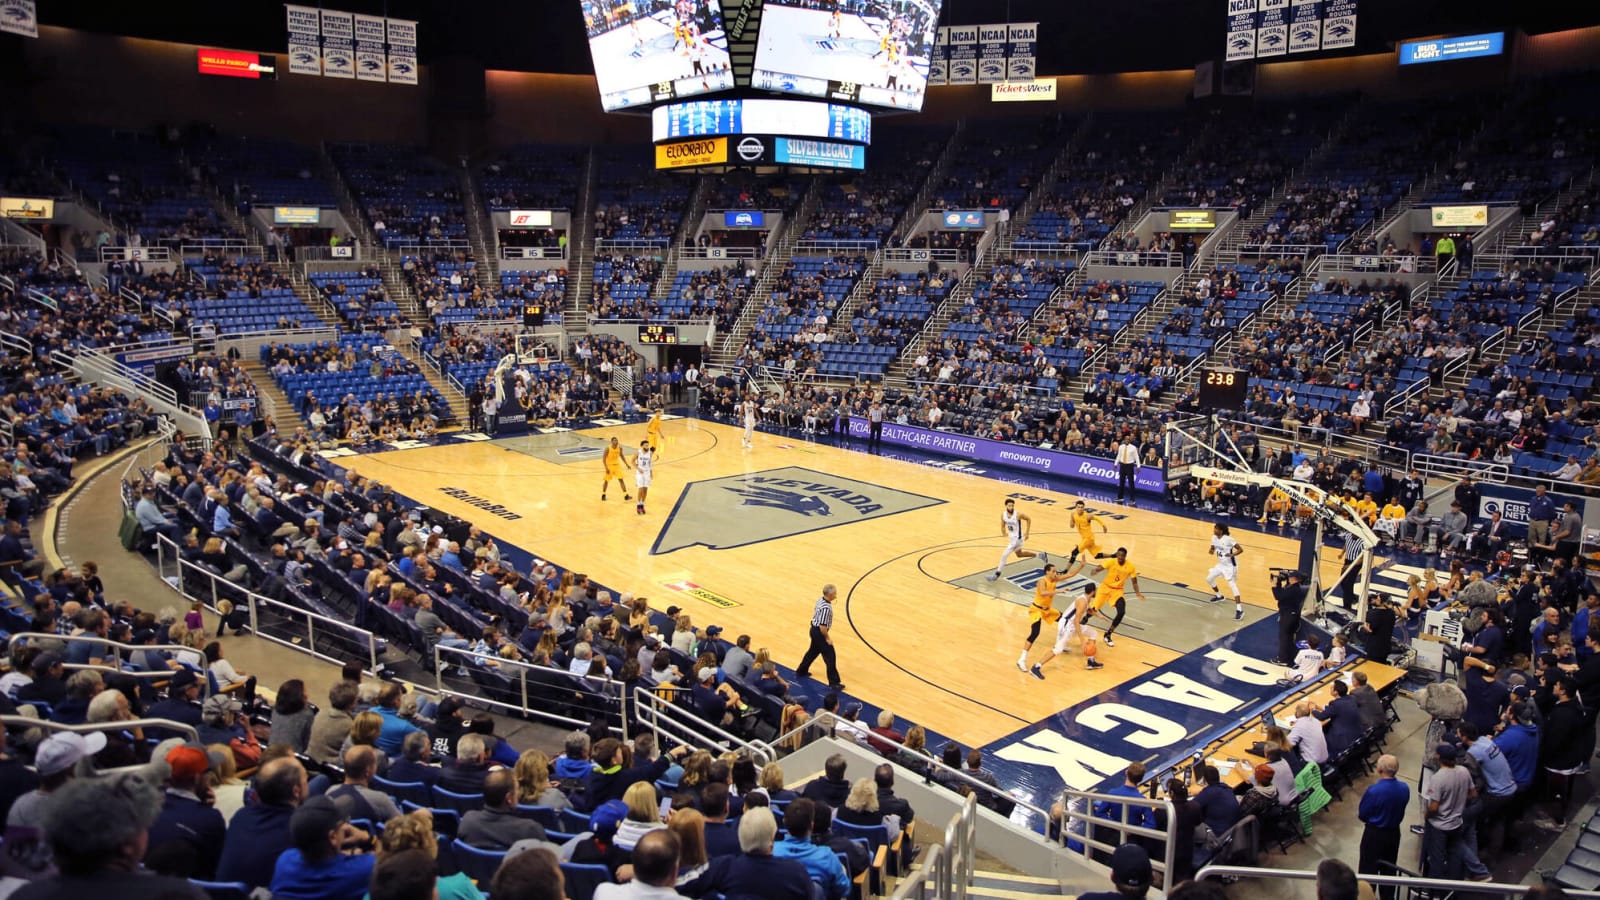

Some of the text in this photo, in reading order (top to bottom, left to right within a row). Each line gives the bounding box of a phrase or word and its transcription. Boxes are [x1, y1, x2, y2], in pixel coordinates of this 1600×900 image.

[1230, 0, 1255, 12] NCAA
[1326, 3, 1356, 13] SECOND
[289, 10, 317, 19] WESTERN
[1297, 9, 1315, 17] FIRST
[1328, 10, 1353, 19] ROUND
[289, 18, 317, 27] ATHLETIC
[323, 15, 351, 24] WESTERN
[356, 19, 382, 28] WESTERN
[731, 7, 749, 39] WOLF
[1295, 15, 1317, 23] ROUND
[1325, 18, 1354, 29] NEVADA
[323, 22, 351, 31] ATHLETIC
[388, 23, 414, 32] WESTERN
[1231, 24, 1252, 32] ROUND
[1262, 20, 1284, 28] ROUND
[1291, 22, 1318, 33] NEVADA
[356, 26, 383, 35] ATHLETIC
[389, 30, 414, 39] ATHLETIC
[1010, 29, 1035, 40] NCAA
[1260, 28, 1286, 37] NEVADA
[951, 31, 976, 42] NCAA
[981, 31, 1005, 41] NCAA
[1229, 32, 1254, 41] NEVADA
[1324, 38, 1354, 46] BASKETBALL
[291, 46, 317, 56] NEVADA
[1417, 43, 1438, 53] BUD
[324, 49, 352, 58] NEVADA
[357, 53, 384, 63] NEVADA
[1413, 50, 1441, 60] LIGHT
[201, 57, 225, 65] WELLS
[226, 60, 249, 68] FARGO
[390, 57, 415, 67] NEVADA
[951, 60, 975, 69] NEVADA
[980, 60, 1004, 69] NEVADA
[1009, 59, 1034, 67] NEVADA
[995, 84, 1052, 93] TicketsWest
[666, 141, 716, 158] ELDORADO
[787, 139, 855, 159] SILVER LEGACY
[513, 215, 531, 224] JET
[914, 251, 927, 259] 20
[1360, 257, 1372, 265] 24
[1207, 373, 1234, 386] 23.8
[881, 427, 932, 446] EALTHCARE
[933, 436, 976, 453] PARTNER
[999, 450, 1051, 468] renown.org
[1079, 462, 1161, 488] Reno HEALTH
[734, 476, 884, 515] NEVADA
[1006, 492, 1056, 506] EST.
[437, 487, 523, 521] #BattleBorn
[1505, 504, 1526, 513] CBS
[993, 648, 1292, 791] PACK
